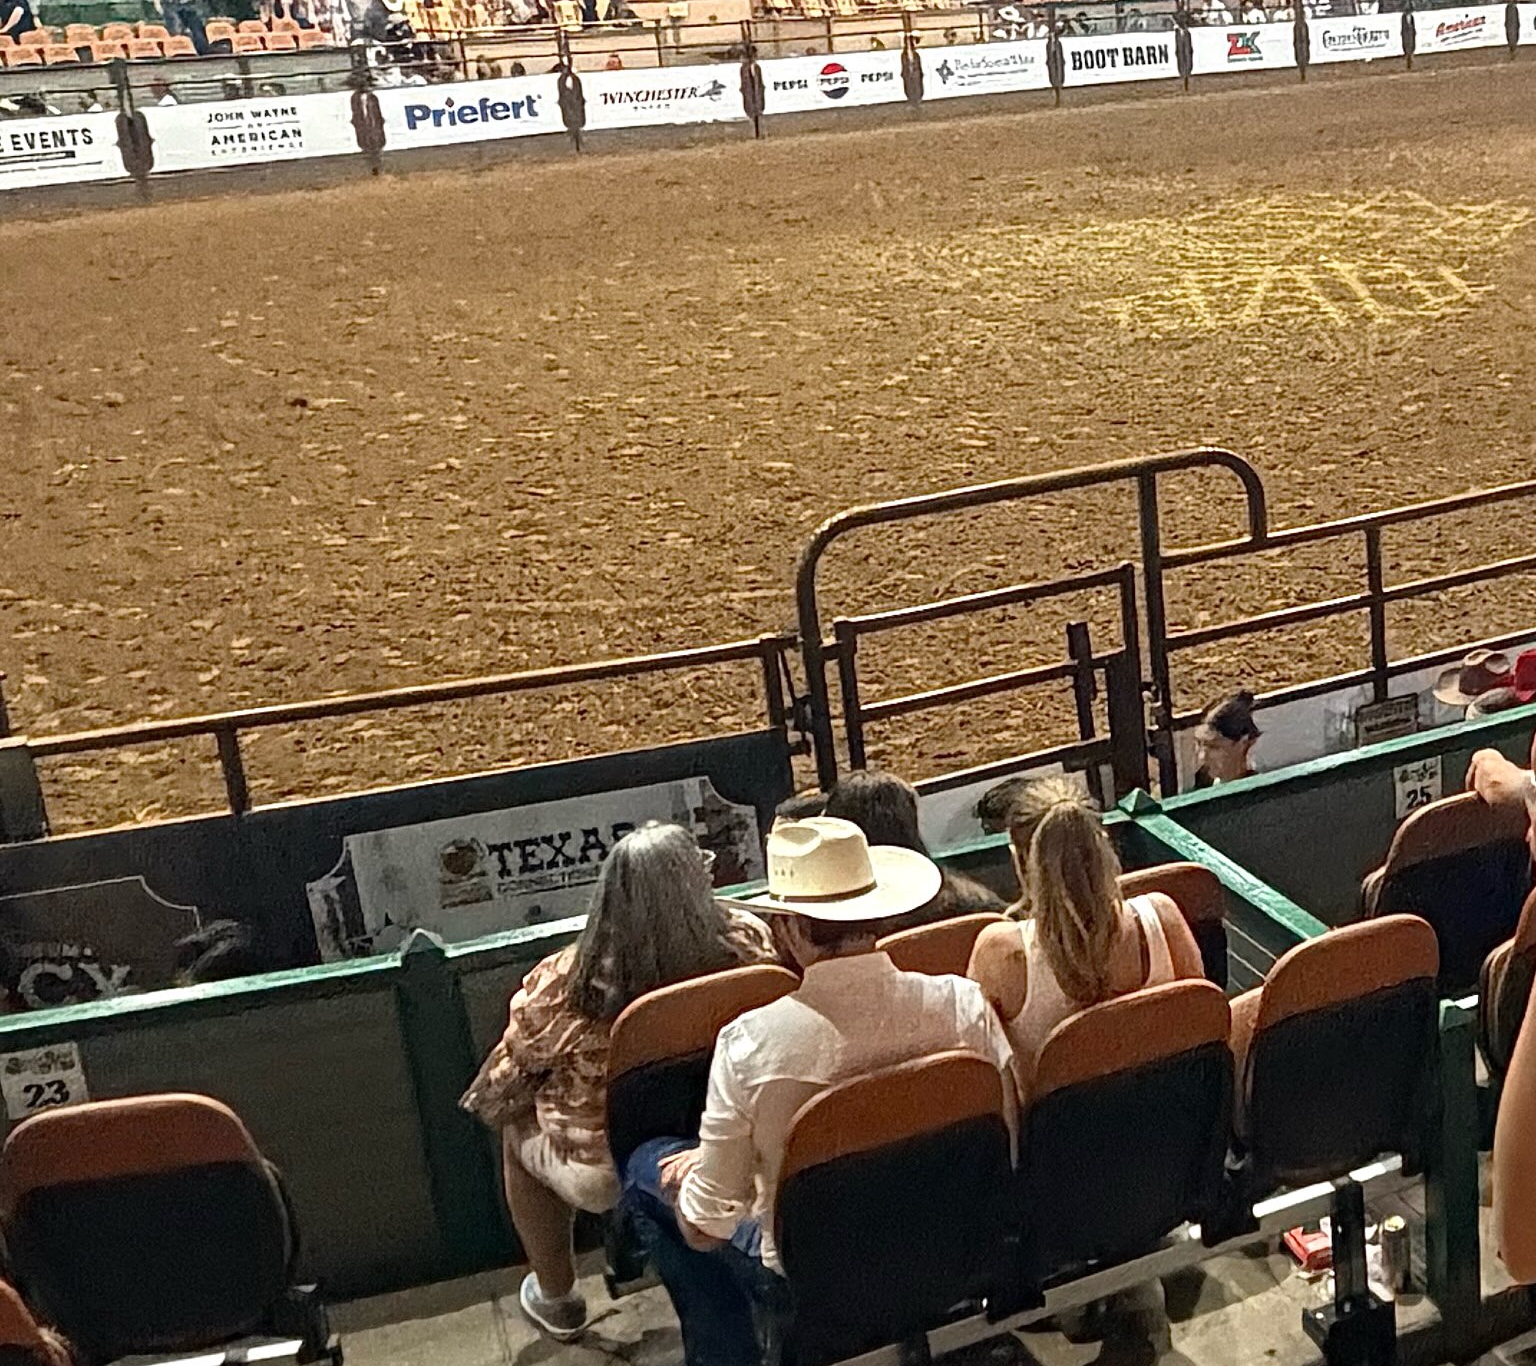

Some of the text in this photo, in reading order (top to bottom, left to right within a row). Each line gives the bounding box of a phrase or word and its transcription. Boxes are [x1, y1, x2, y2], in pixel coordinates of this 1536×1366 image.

[1071, 44, 1169, 71] BOOT BARN
[773, 79, 809, 91] PEPSI
[860, 71, 894, 83] PEPSI
[600, 86, 699, 105] WINCHESTER
[207, 106, 297, 124] JOHN WAYNE
[404, 95, 539, 131] Priefert
[11, 127, 94, 151] EVENTS
[211, 128, 302, 146] AMERICAN
[1406, 786, 1432, 809] 25
[24, 1080, 69, 1108] 23
